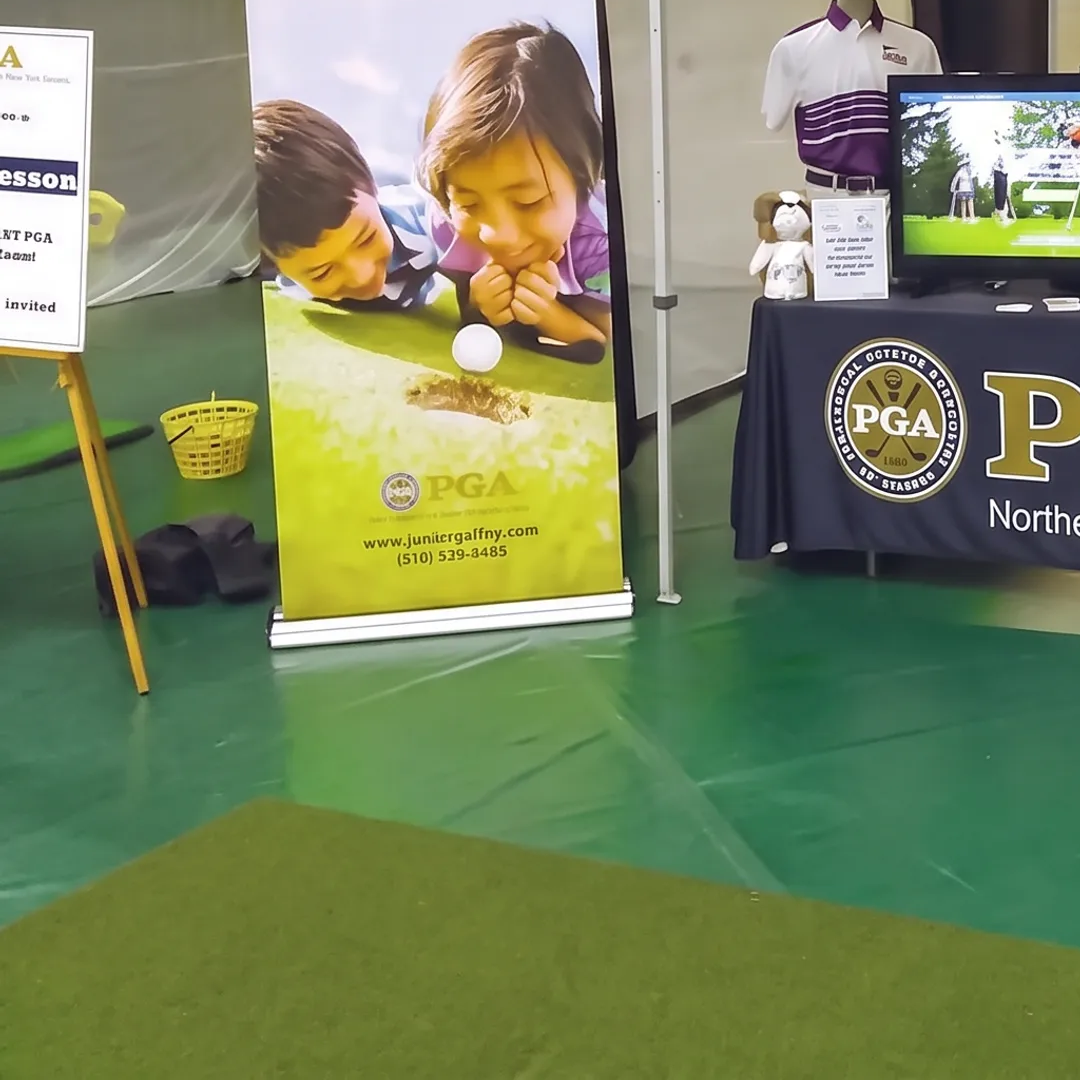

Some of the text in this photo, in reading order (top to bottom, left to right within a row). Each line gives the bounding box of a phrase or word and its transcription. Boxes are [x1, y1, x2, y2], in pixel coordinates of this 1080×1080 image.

[0, 45, 23, 68] A
[0, 168, 77, 191] esson
[24, 231, 54, 244] PGA
[5, 298, 57, 313] invited
[851, 404, 940, 439] PGA
[426, 471, 518, 501] PGA
[397, 551, 434, 567] (510)
